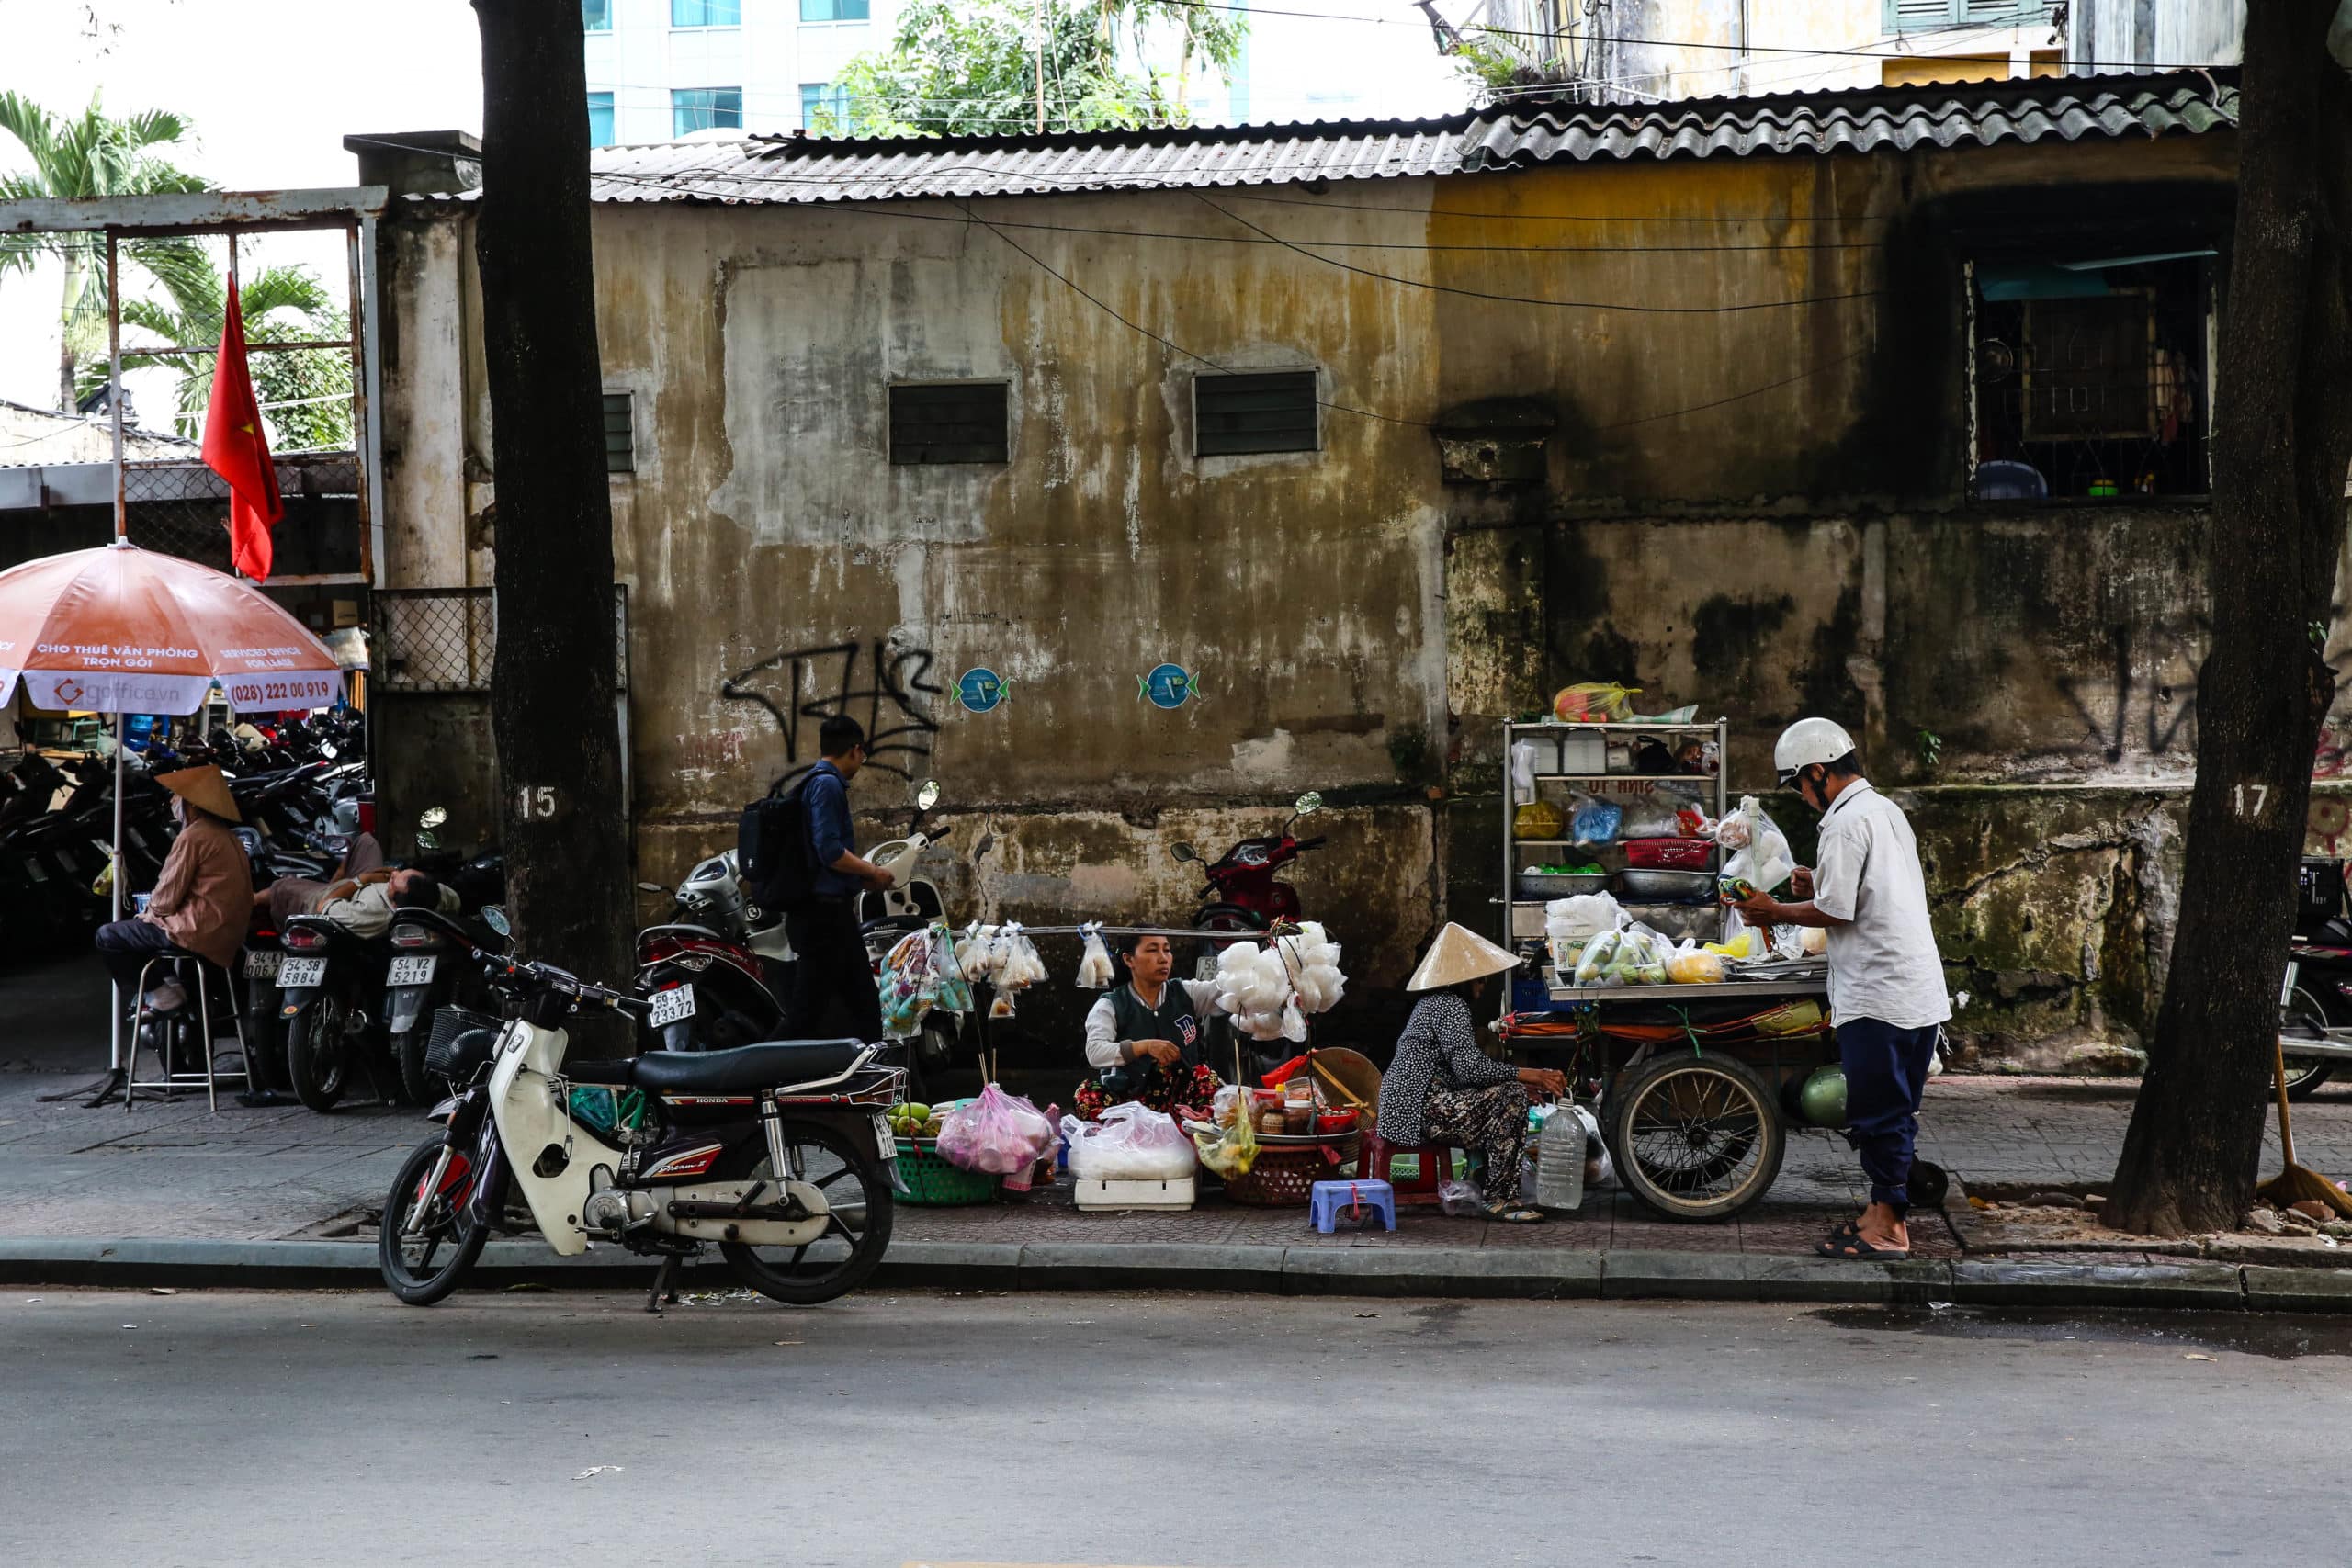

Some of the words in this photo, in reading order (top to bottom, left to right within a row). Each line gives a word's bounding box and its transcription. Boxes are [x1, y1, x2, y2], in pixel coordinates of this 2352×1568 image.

[37, 644, 70, 654] CHO
[74, 644, 108, 655] THUÊ
[114, 645, 142, 656] VĂN
[146, 645, 198, 659] PHÒNG
[83, 657, 120, 669] TRỌN
[125, 656, 152, 668] GÓI
[86, 682, 180, 705] goffice.vn
[232, 685, 263, 705] (028)
[266, 682, 288, 699] 222
[290, 682, 305, 698] 00
[307, 682, 329, 696] 919
[520, 786, 555, 818] 15
[2234, 784, 2268, 816] 17
[397, 958, 429, 970] 54-V2
[284, 973, 315, 984] 5884
[394, 970, 426, 983] 5219
[654, 1001, 692, 1024] 233.72
